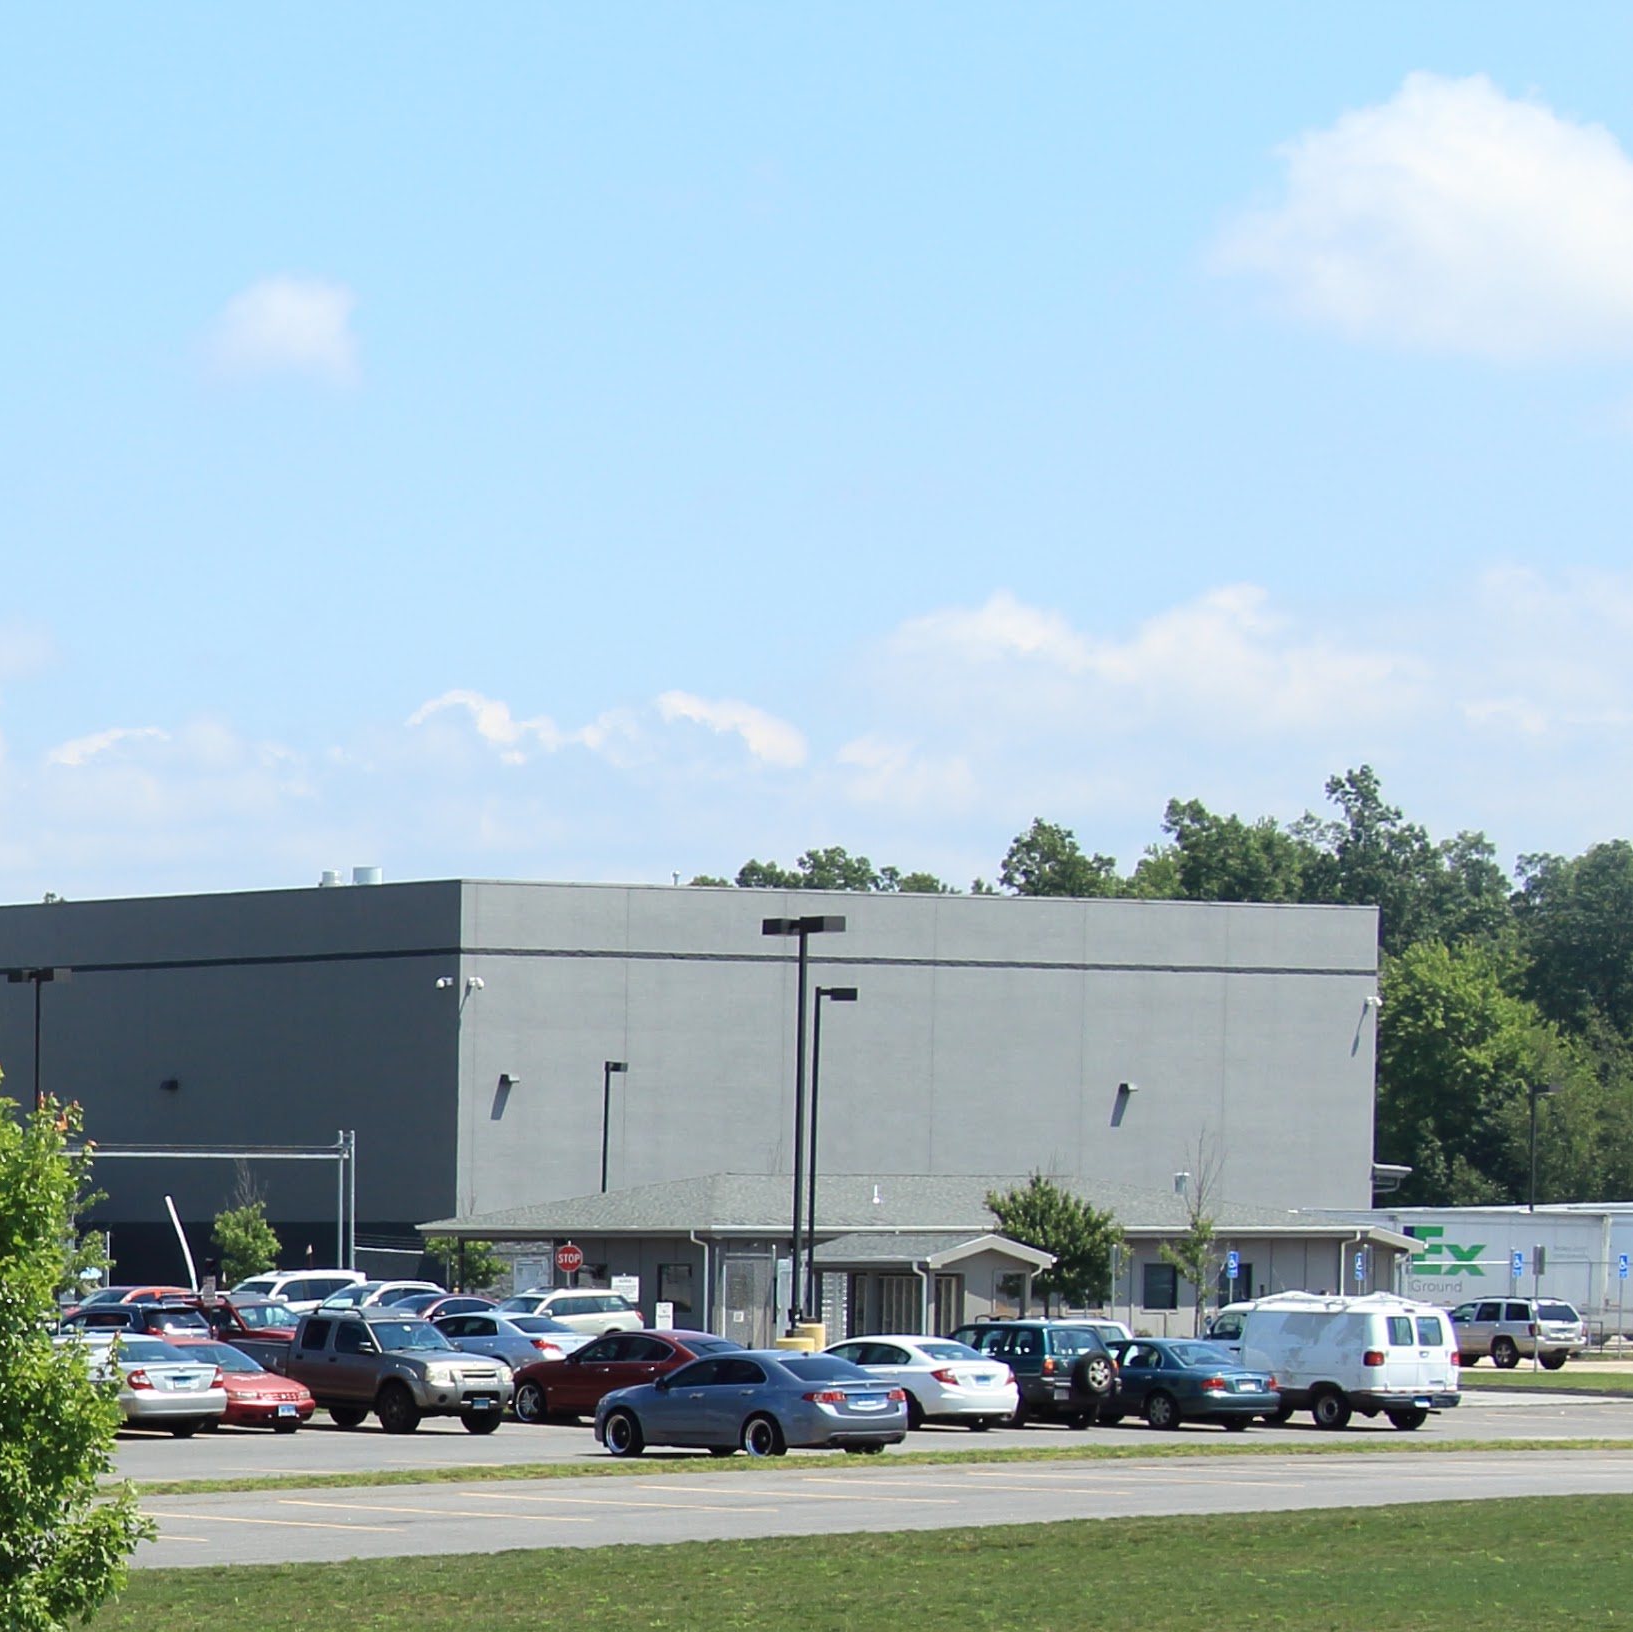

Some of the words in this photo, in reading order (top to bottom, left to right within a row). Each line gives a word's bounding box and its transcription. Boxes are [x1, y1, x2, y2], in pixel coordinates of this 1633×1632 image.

[1403, 1226, 1486, 1276] Ex
[558, 1253, 581, 1264] STOP
[1411, 1280, 1463, 1293] Ground
